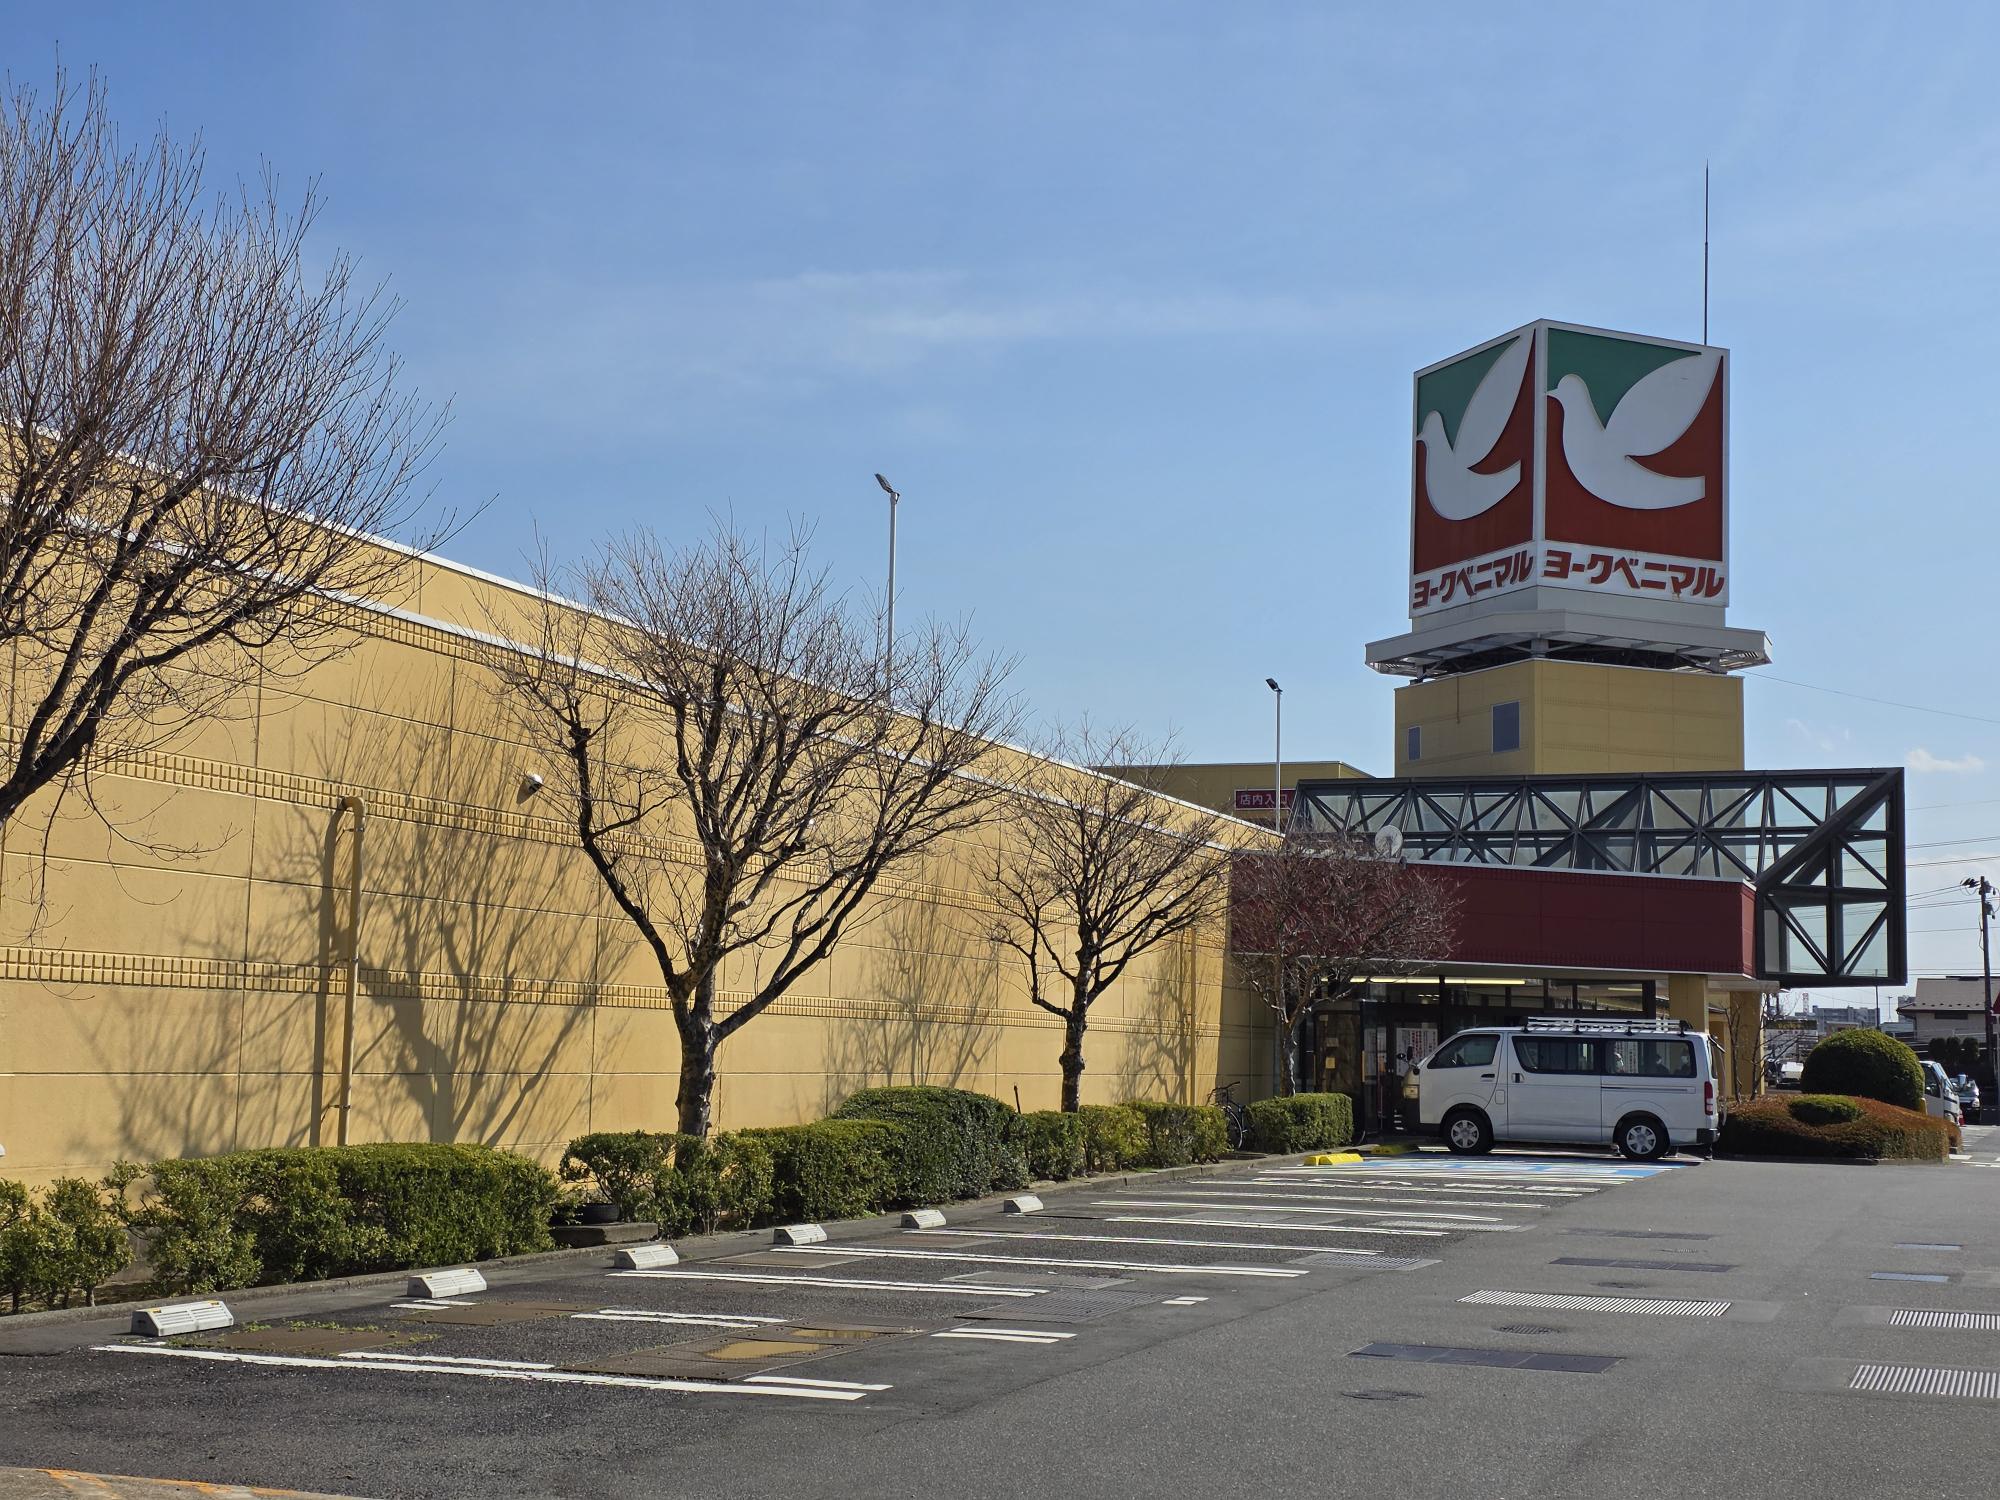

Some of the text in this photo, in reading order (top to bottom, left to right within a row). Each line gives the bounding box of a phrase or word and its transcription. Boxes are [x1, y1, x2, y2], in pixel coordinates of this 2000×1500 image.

[1412, 550, 1533, 609] ヨークベニマル
[1543, 550, 1725, 598] ヨークベニマル
